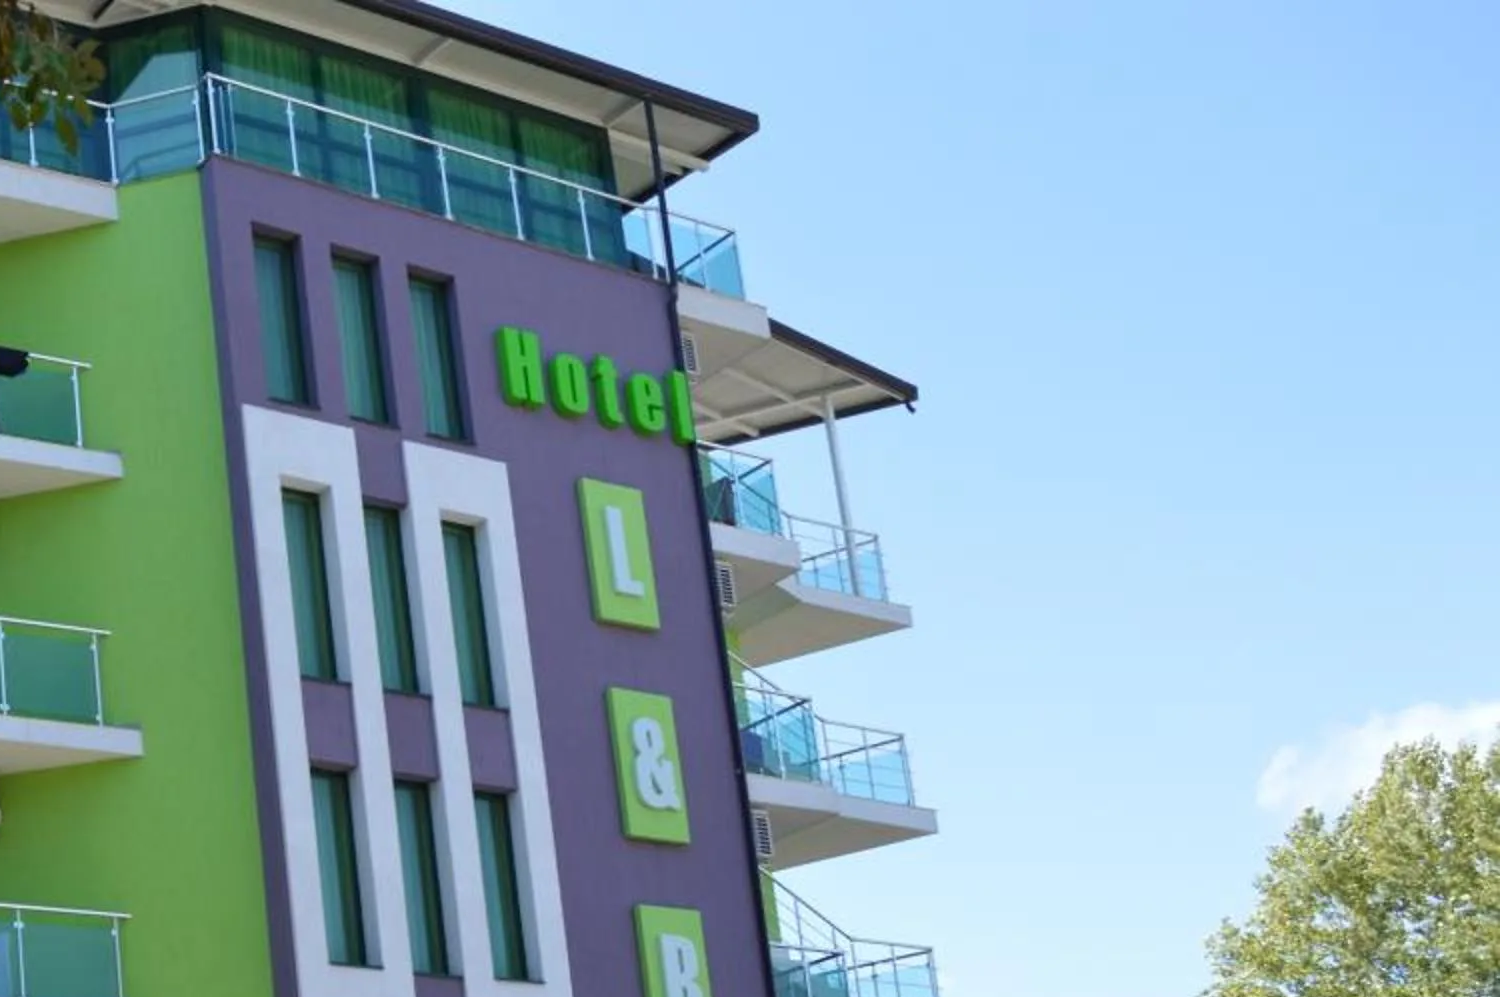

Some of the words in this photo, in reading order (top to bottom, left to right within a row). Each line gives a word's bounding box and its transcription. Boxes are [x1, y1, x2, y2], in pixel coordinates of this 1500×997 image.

[495, 325, 695, 446] Hotel
[604, 505, 644, 597] L
[631, 716, 681, 812] &
